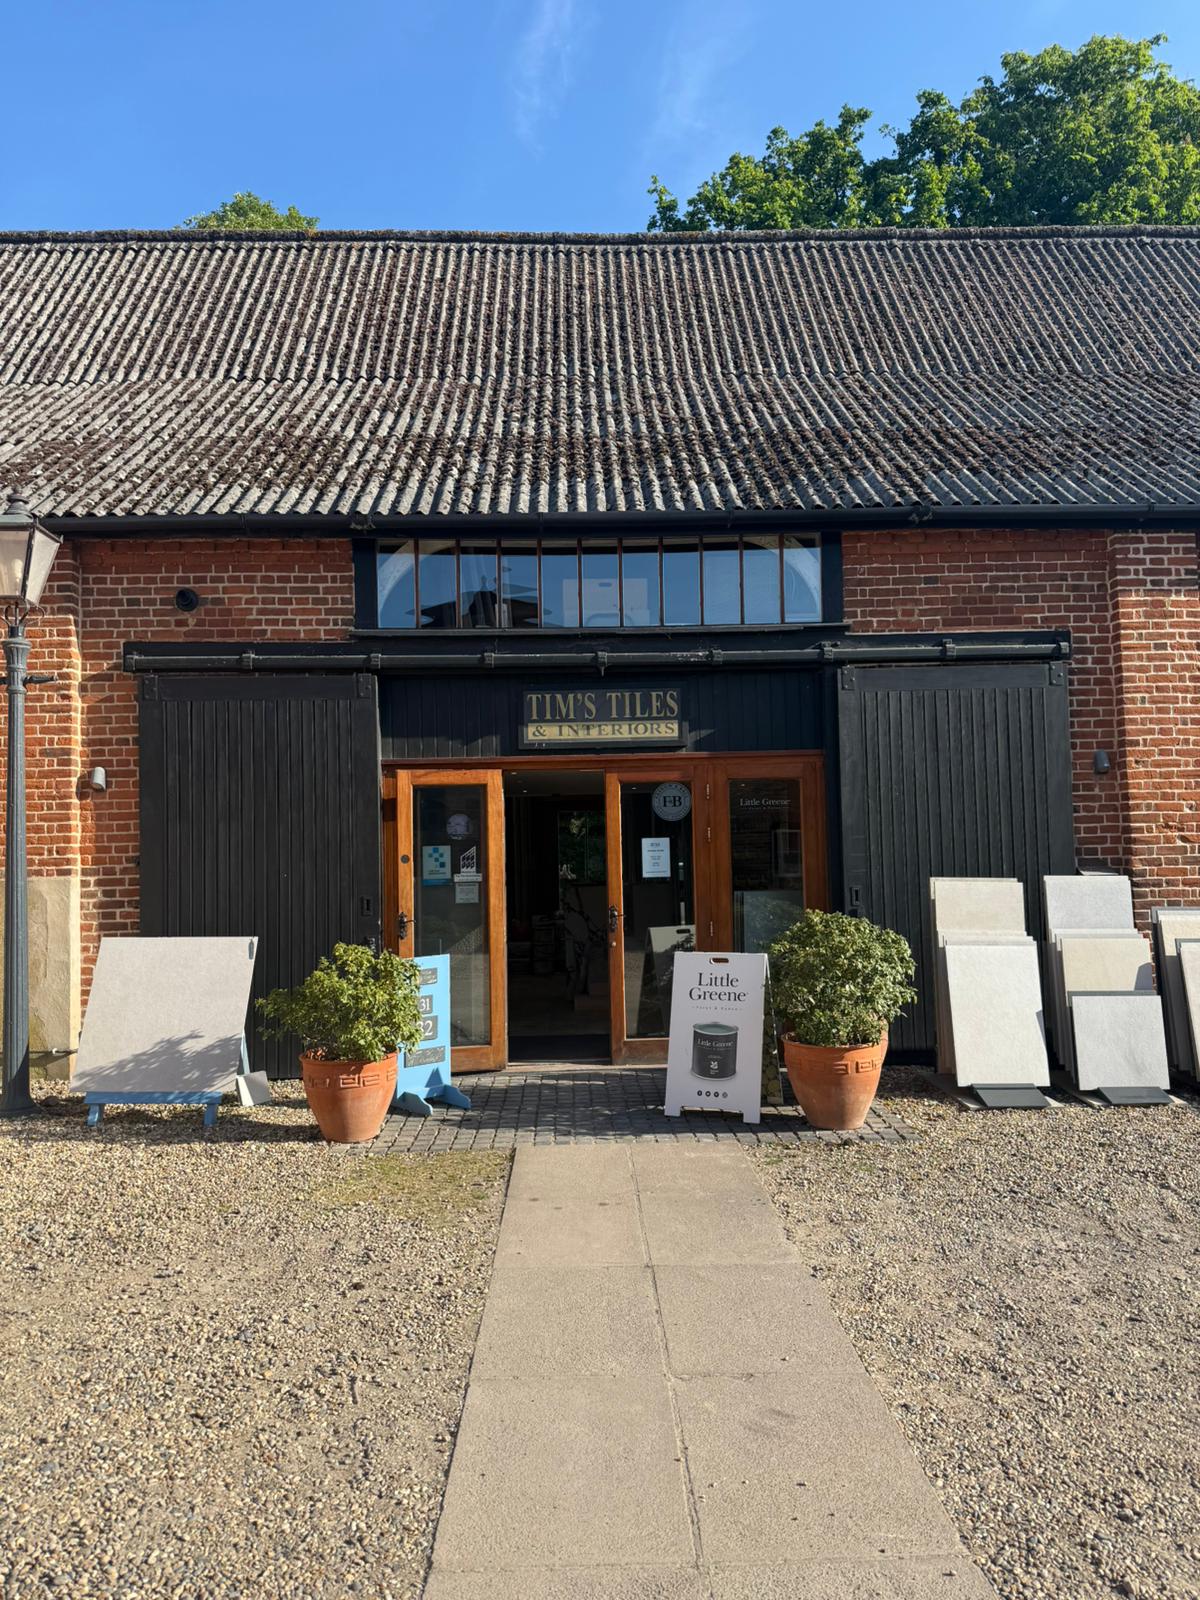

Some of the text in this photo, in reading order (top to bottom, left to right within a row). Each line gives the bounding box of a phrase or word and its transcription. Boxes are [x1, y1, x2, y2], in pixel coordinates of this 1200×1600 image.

[527, 690, 679, 720] TIM'S TILES
[532, 722, 675, 737] & INTERIORS
[740, 798, 791, 806] Little Greene
[697, 973, 739, 988] Little
[689, 986, 746, 1002] Greene
